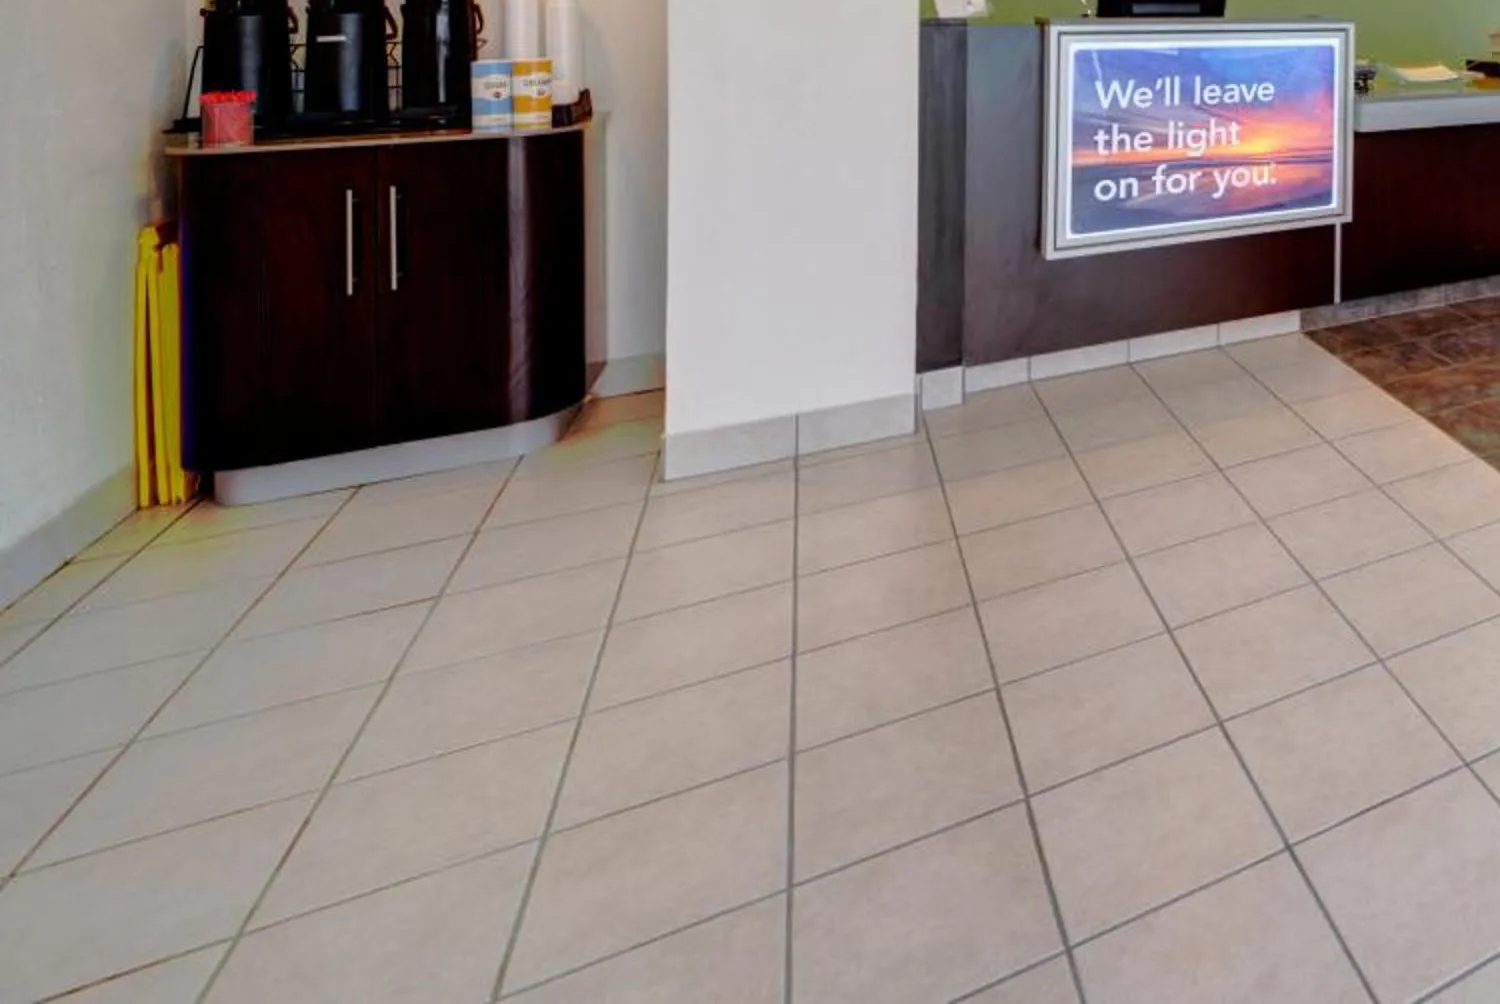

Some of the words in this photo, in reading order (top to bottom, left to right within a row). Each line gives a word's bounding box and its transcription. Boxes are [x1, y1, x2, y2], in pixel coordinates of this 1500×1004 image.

[1094, 76, 1181, 109] We'll
[1193, 76, 1275, 106] leave
[1093, 122, 1153, 156] the
[1167, 119, 1241, 157] light
[1094, 176, 1139, 201] on
[1152, 162, 1202, 195] for
